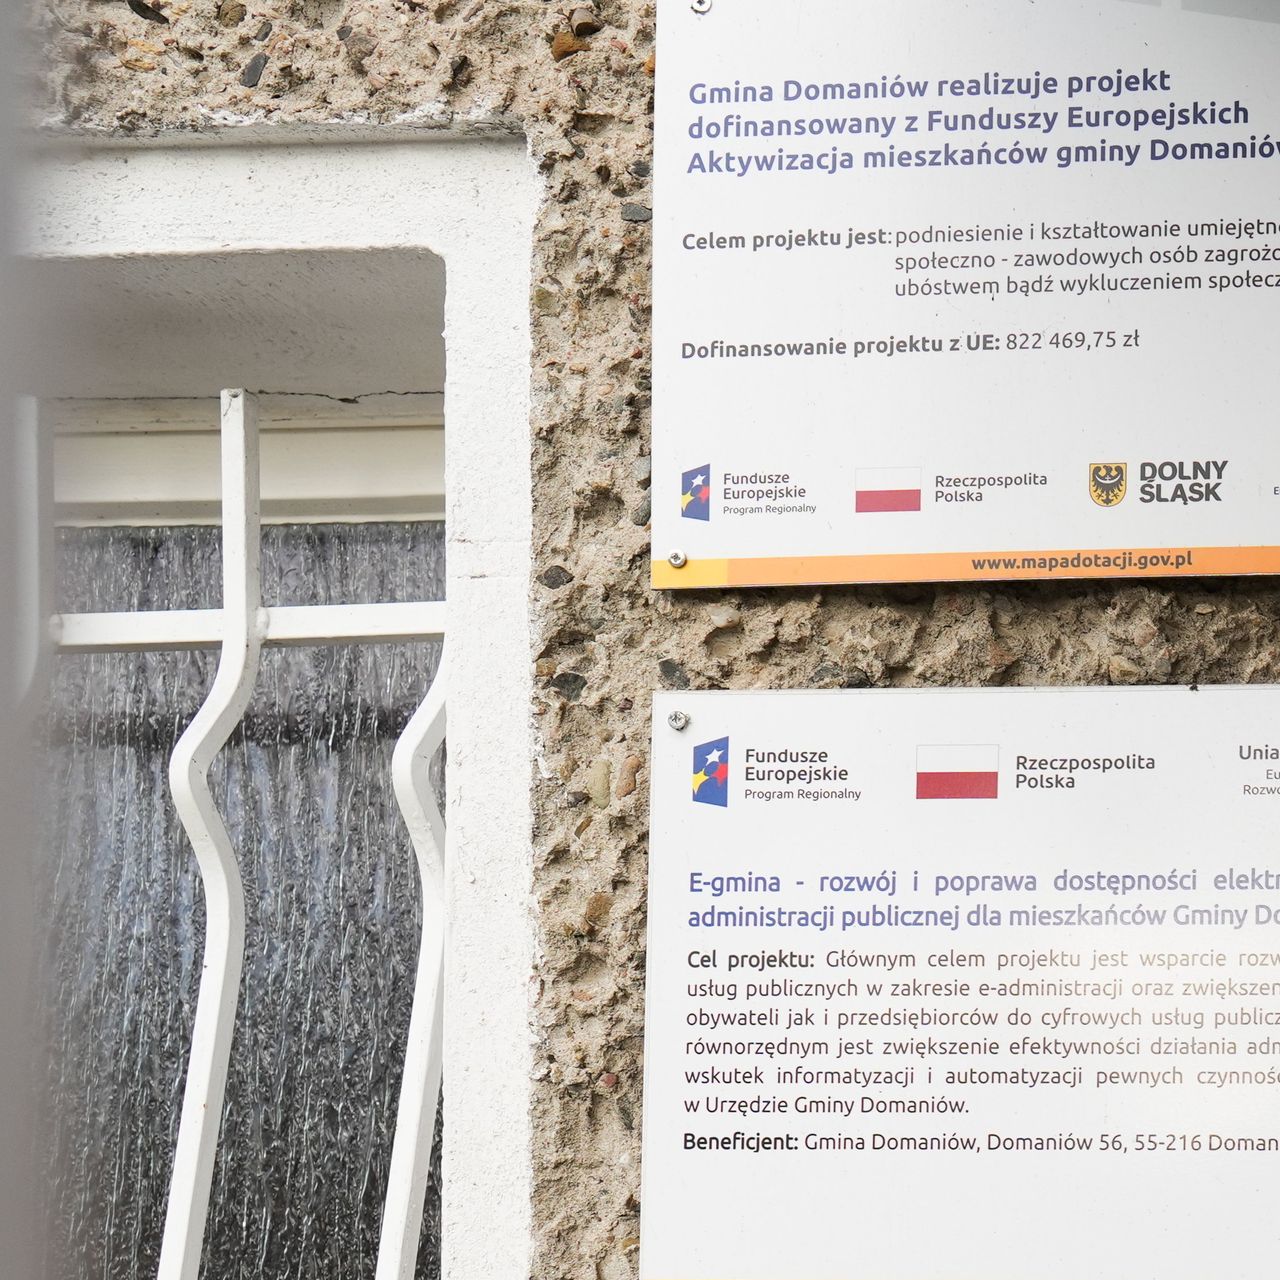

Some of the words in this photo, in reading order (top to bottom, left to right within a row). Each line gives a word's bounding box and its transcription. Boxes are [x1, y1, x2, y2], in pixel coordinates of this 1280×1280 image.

[689, 80, 774, 105] Gmina
[783, 74, 929, 102] Domaniów
[937, 70, 1059, 100] realizuje
[1067, 67, 1171, 99] projekt
[688, 114, 897, 139] dofinansowany
[927, 106, 1059, 134] Funduszy
[1067, 100, 1249, 132] Europejskich
[686, 146, 854, 178] Aktywizacja
[863, 140, 1048, 169] mieszkańców
[1056, 138, 1141, 169] gminy
[682, 231, 746, 251] Celem
[752, 228, 841, 252] projektu
[845, 227, 892, 250] jest:
[895, 223, 1024, 248] podniesienie
[1041, 219, 1181, 240] kształtowanie
[895, 251, 996, 274] społeczno
[1013, 245, 1143, 269] zawodowych
[1149, 244, 1199, 264] osób
[895, 277, 1000, 297] ubóstwem
[1006, 274, 1054, 297] bądź
[1059, 272, 1202, 296] wykluczeniem
[681, 336, 847, 360] Dofinansowanie
[853, 334, 943, 358] projektu
[966, 333, 1001, 352] UE:
[1006, 332, 1042, 351] 822
[1048, 330, 1117, 352] 469,75
[1122, 328, 1140, 348] zł
[723, 472, 790, 486] Fundusze
[935, 473, 1048, 490] Rzeczpospolita
[1140, 460, 1228, 481] DOLNY
[723, 486, 807, 502] Europejskie
[934, 489, 983, 503] Polska
[1139, 479, 1222, 505] ŚLĄSK
[722, 505, 764, 517] Program
[764, 503, 817, 516] Regionalny
[971, 549, 1193, 572] www.mapadotacji.gov.pl
[745, 748, 829, 764] Fundusze
[1016, 753, 1156, 774] Rzeczpospolita
[1238, 743, 1280, 761] Unia
[744, 765, 849, 785] Europejskie
[1015, 773, 1076, 789] Polska
[744, 788, 795, 802] Program
[796, 787, 862, 802] Regionalny
[689, 870, 782, 898] E-gmina
[819, 869, 898, 898] rozwój
[934, 874, 1038, 897] poprawa
[1052, 867, 1198, 896] dostępności
[687, 904, 836, 933] administracji
[841, 903, 961, 932] publicznej
[965, 903, 1002, 927] dla
[1008, 902, 1168, 927] mieszkańców
[1172, 903, 1249, 931] Gminy
[686, 948, 719, 970] Cel
[727, 948, 816, 973] projektu:
[825, 948, 917, 972] Głównym
[926, 948, 986, 968] celem
[996, 948, 1081, 972] projektu
[1089, 948, 1129, 972] jest
[1138, 948, 1227, 971] wsparcie
[683, 1100, 701, 1113] w
[705, 1095, 789, 1118] Urzędzie
[794, 1095, 855, 1118] Gminy
[860, 1095, 970, 1114] Domaniów.
[683, 1130, 799, 1154] Beneficjent:
[804, 1132, 866, 1151] Gmina
[871, 1132, 981, 1154] Domaniów,
[987, 1132, 1094, 1151] Domaniów
[1099, 1133, 1128, 1154] 56,
[1134, 1133, 1202, 1152] 55-216
